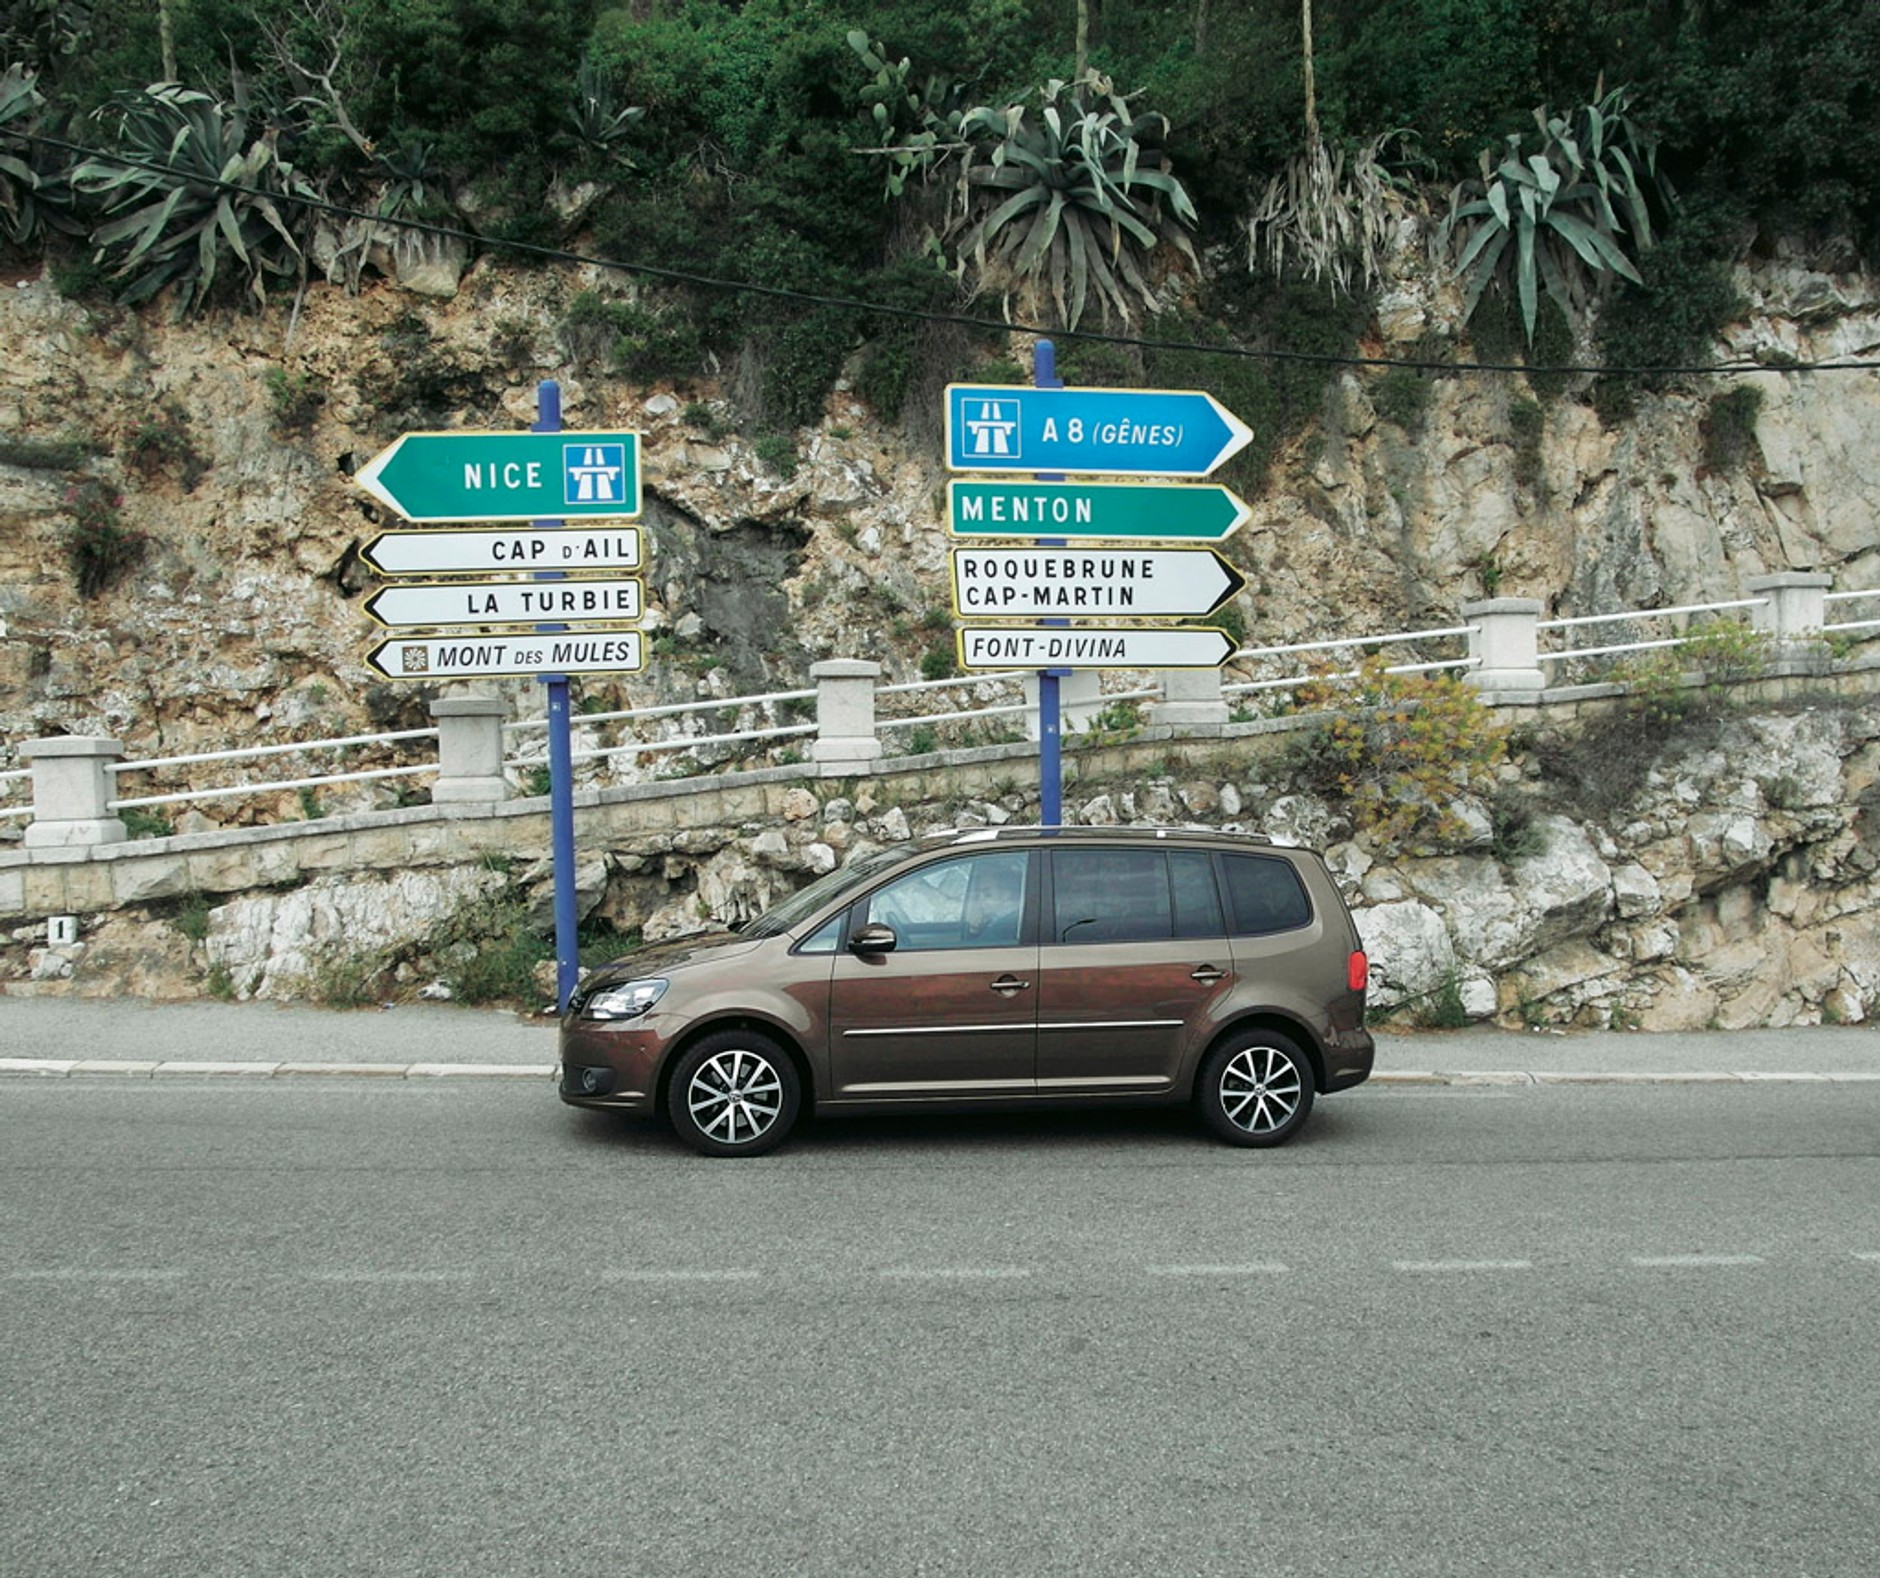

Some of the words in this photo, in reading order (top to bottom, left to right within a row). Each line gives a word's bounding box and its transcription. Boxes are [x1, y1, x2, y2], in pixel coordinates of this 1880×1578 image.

[1042, 418, 1058, 443] A
[1067, 418, 1084, 443] 8
[1092, 418, 1184, 448] (GÊNES)
[464, 462, 542, 489] NICE
[961, 496, 1092, 523] MENTON
[492, 540, 545, 561] CAP
[964, 558, 1154, 579] ROQUEBRUNE
[467, 594, 499, 614] LA
[521, 589, 630, 612] TURBIE
[966, 585, 1134, 606] CAP-MARTIN
[437, 645, 507, 668] MONT
[514, 650, 543, 665] DES
[551, 641, 630, 664] MULES
[973, 637, 1127, 658] FONT-DIVINA
